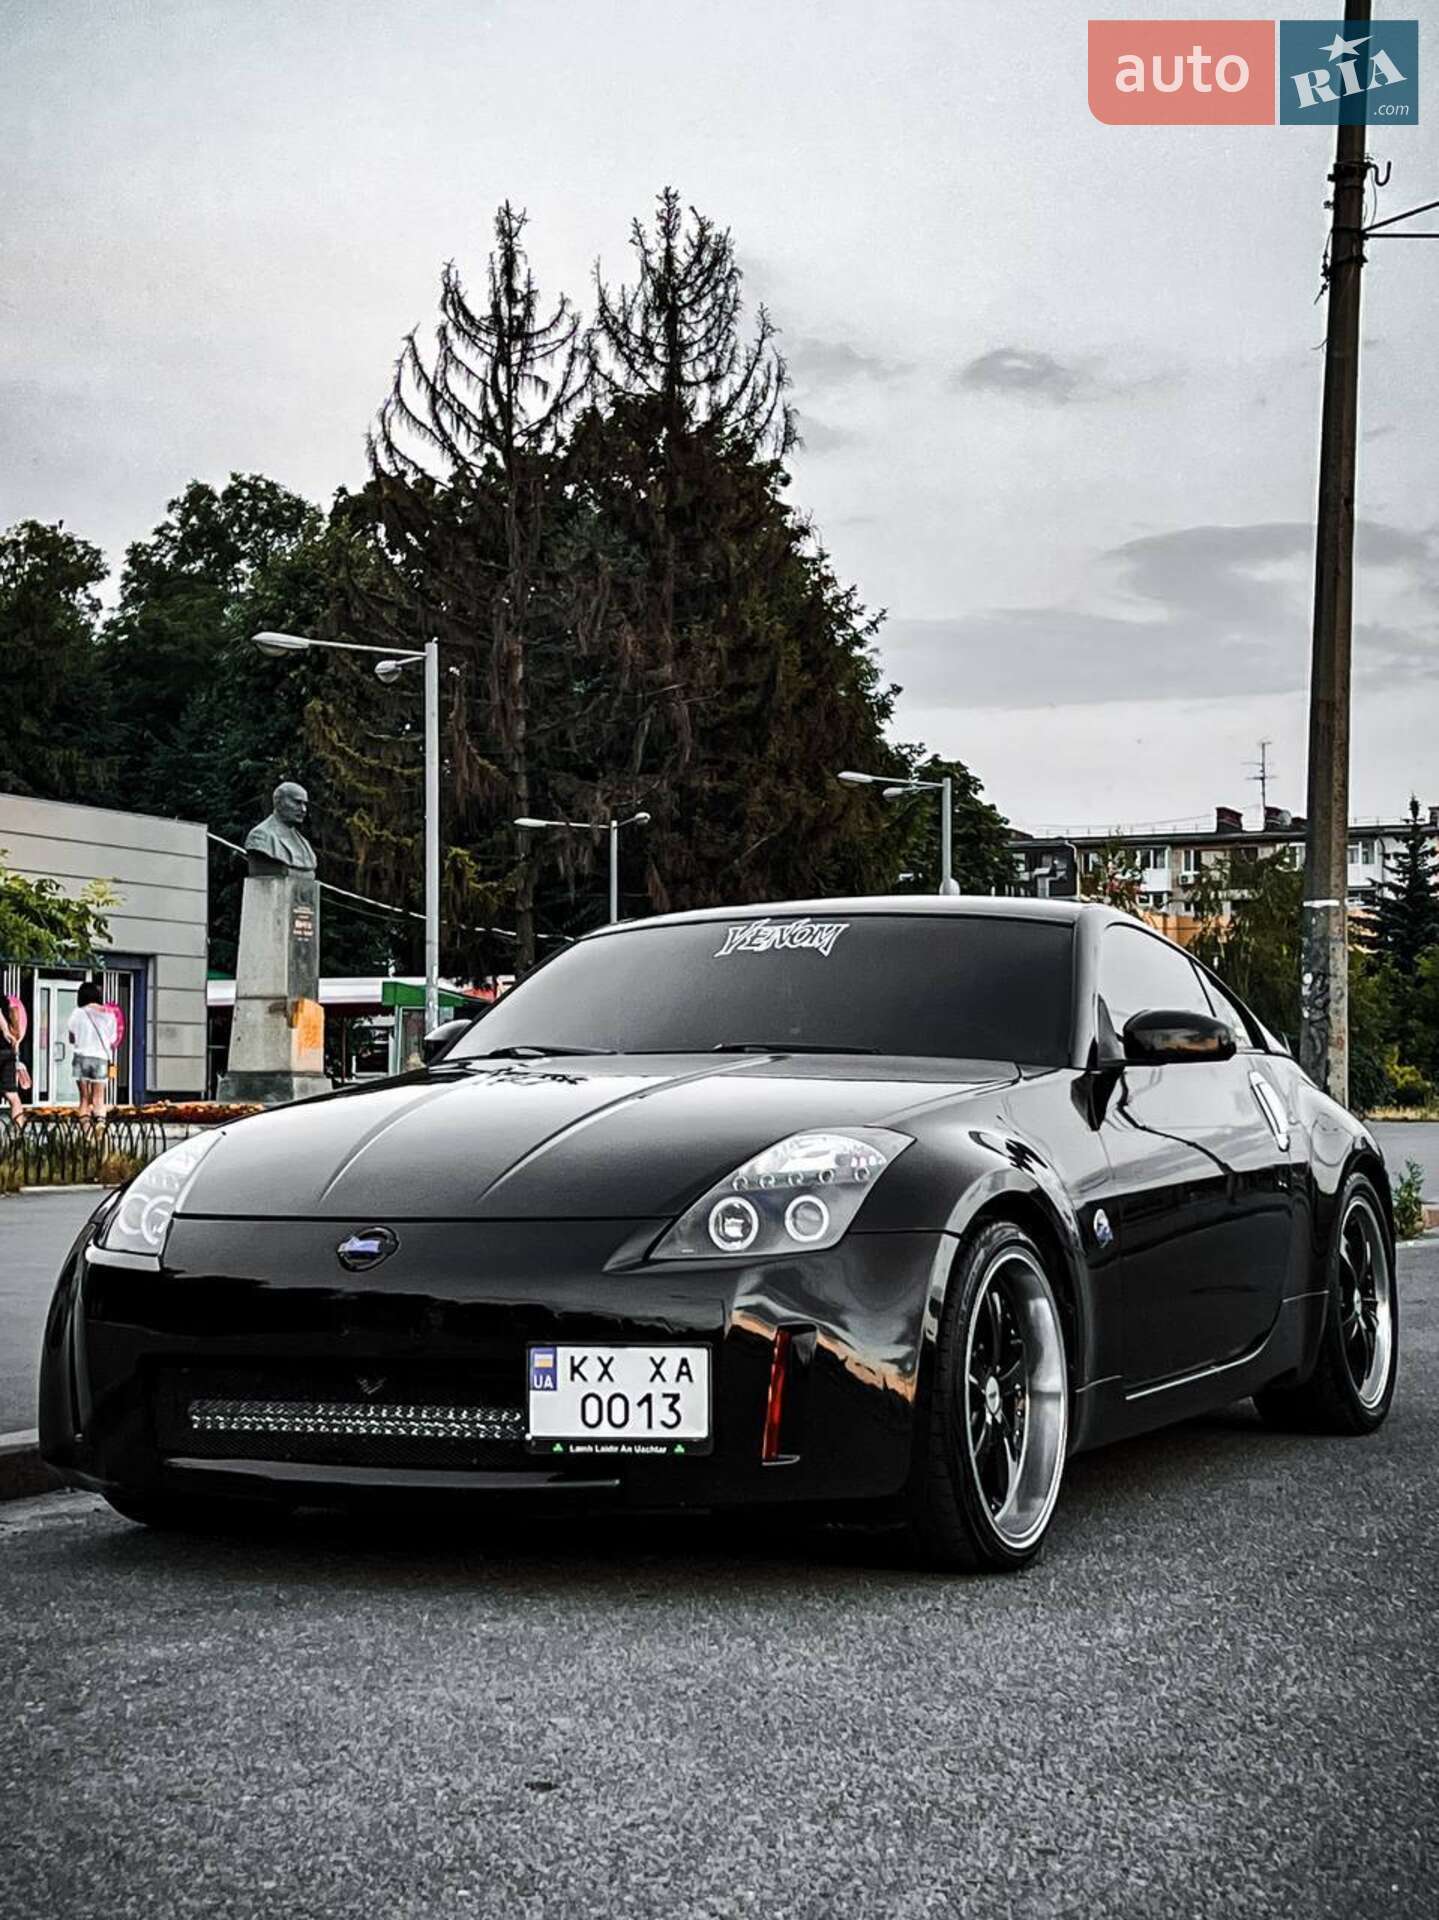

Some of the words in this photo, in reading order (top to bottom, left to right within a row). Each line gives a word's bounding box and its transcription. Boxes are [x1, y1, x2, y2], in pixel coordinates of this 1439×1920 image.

[713, 917, 850, 957] VENOM
[533, 1374, 554, 1389] UA
[569, 1355, 614, 1382] KX
[649, 1355, 694, 1383] XA
[580, 1392, 682, 1429] 0013
